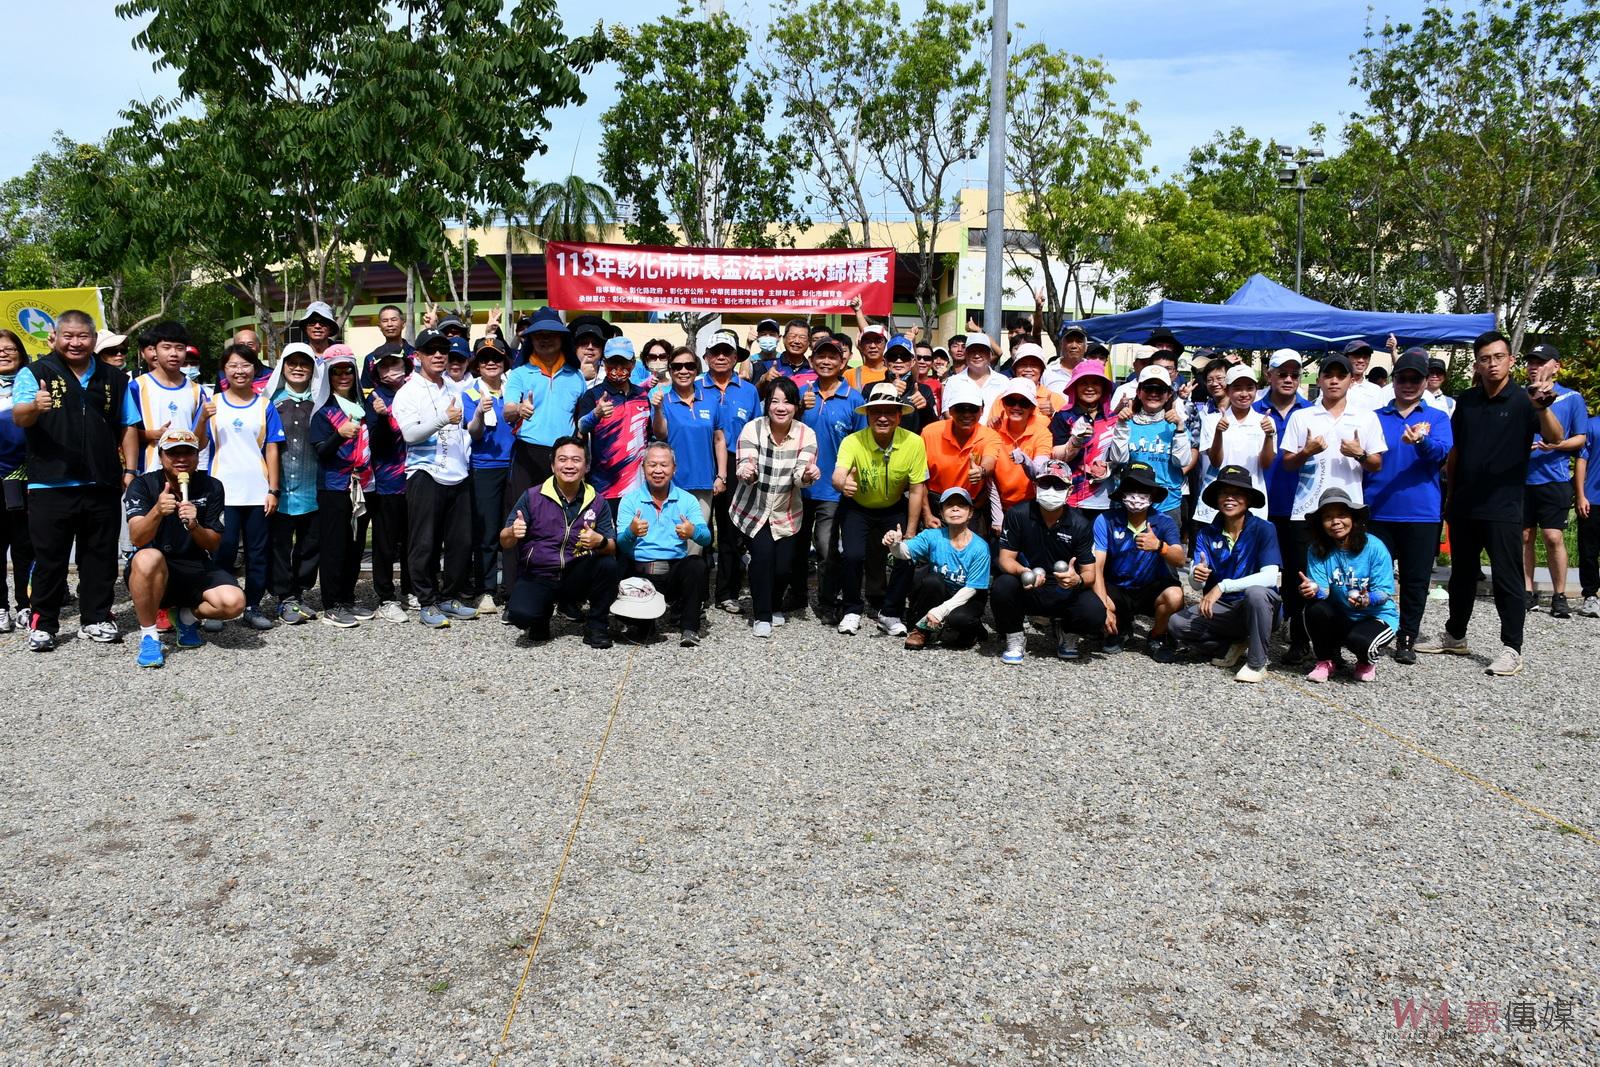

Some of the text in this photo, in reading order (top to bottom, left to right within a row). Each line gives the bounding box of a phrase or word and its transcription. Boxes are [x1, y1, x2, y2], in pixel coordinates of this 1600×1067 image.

[556, 252, 889, 284] 113年彰化市市長盃法式滾球錦標賽
